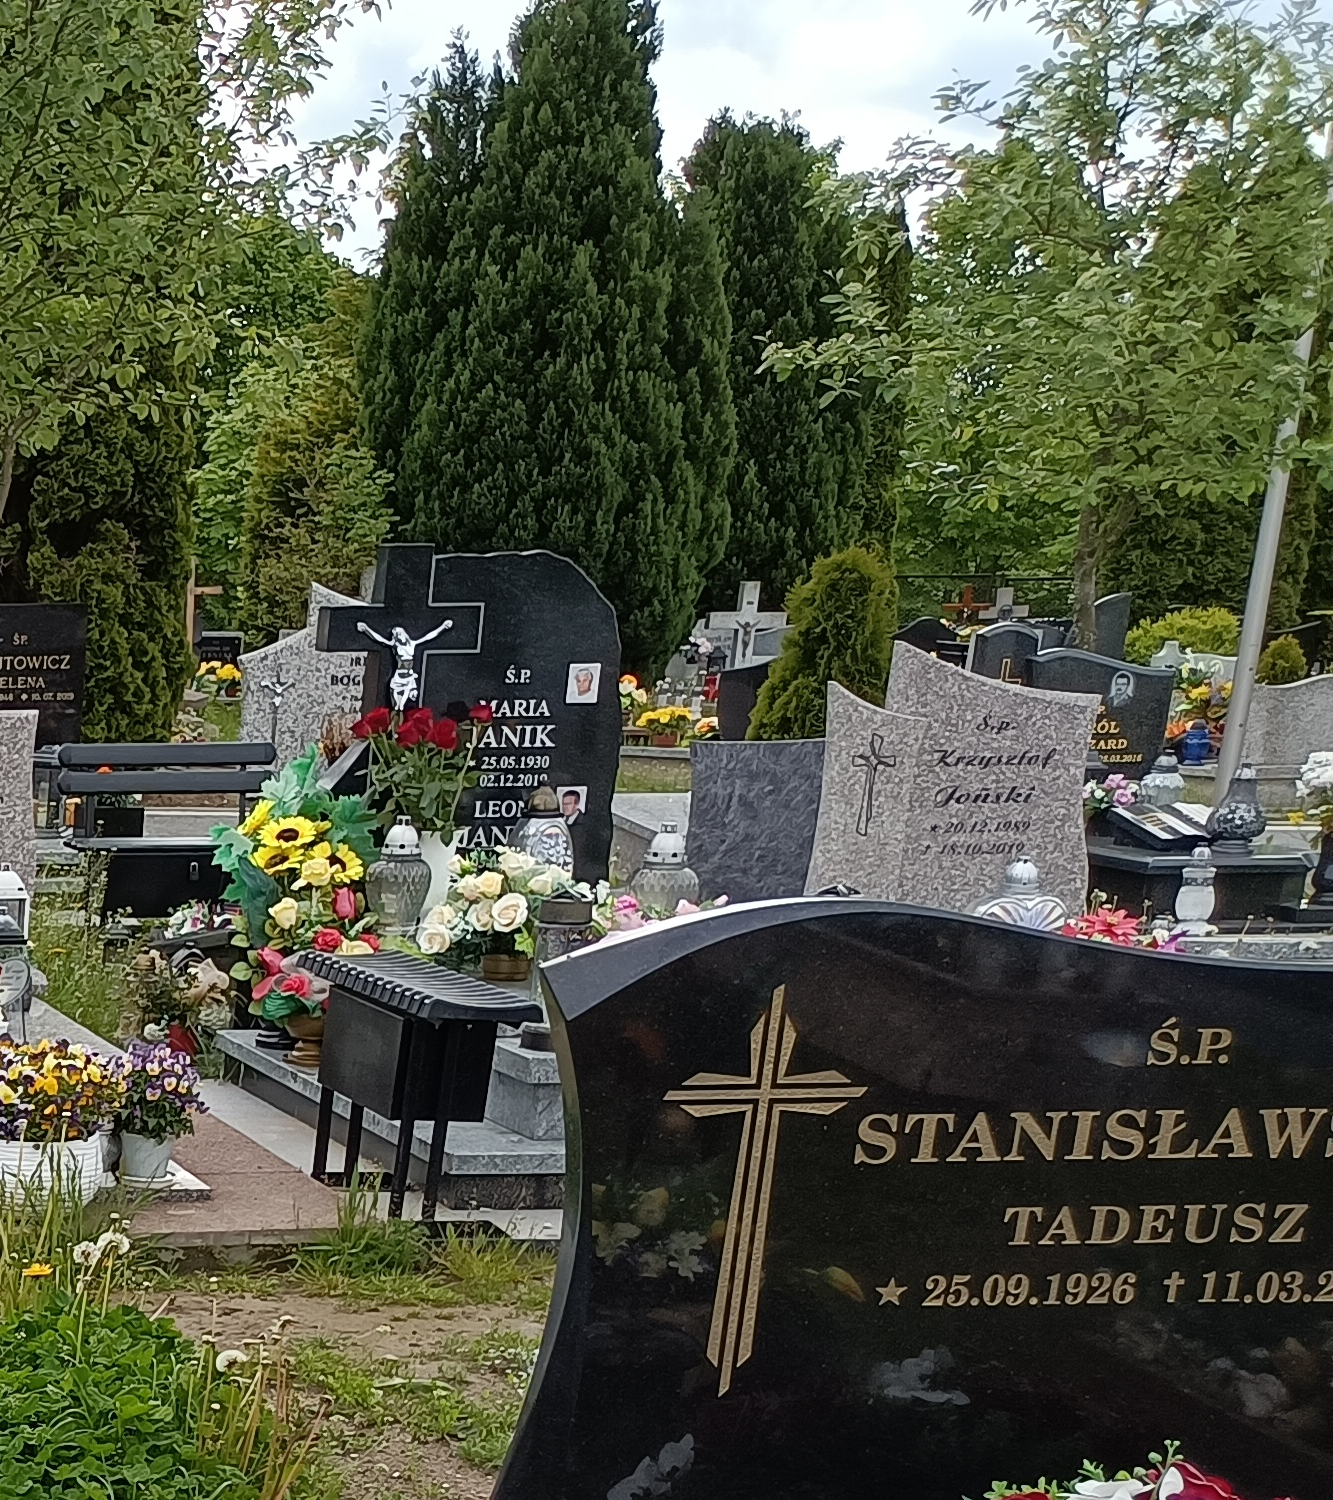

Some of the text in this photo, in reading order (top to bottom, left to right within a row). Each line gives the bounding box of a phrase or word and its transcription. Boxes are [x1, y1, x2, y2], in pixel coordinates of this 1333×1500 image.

[504, 664, 531, 684] Ś.P.
[480, 755, 550, 770] 25.05.1930
[933, 747, 1058, 770] Krzysztof
[455, 825, 516, 850] JAN
[1146, 1016, 1233, 1067] Ś.P.
[853, 1107, 1333, 1165] STANISŁAW
[1004, 1203, 1310, 1247] TADEUSZ
[922, 1271, 1138, 1307] 25.09.1926
